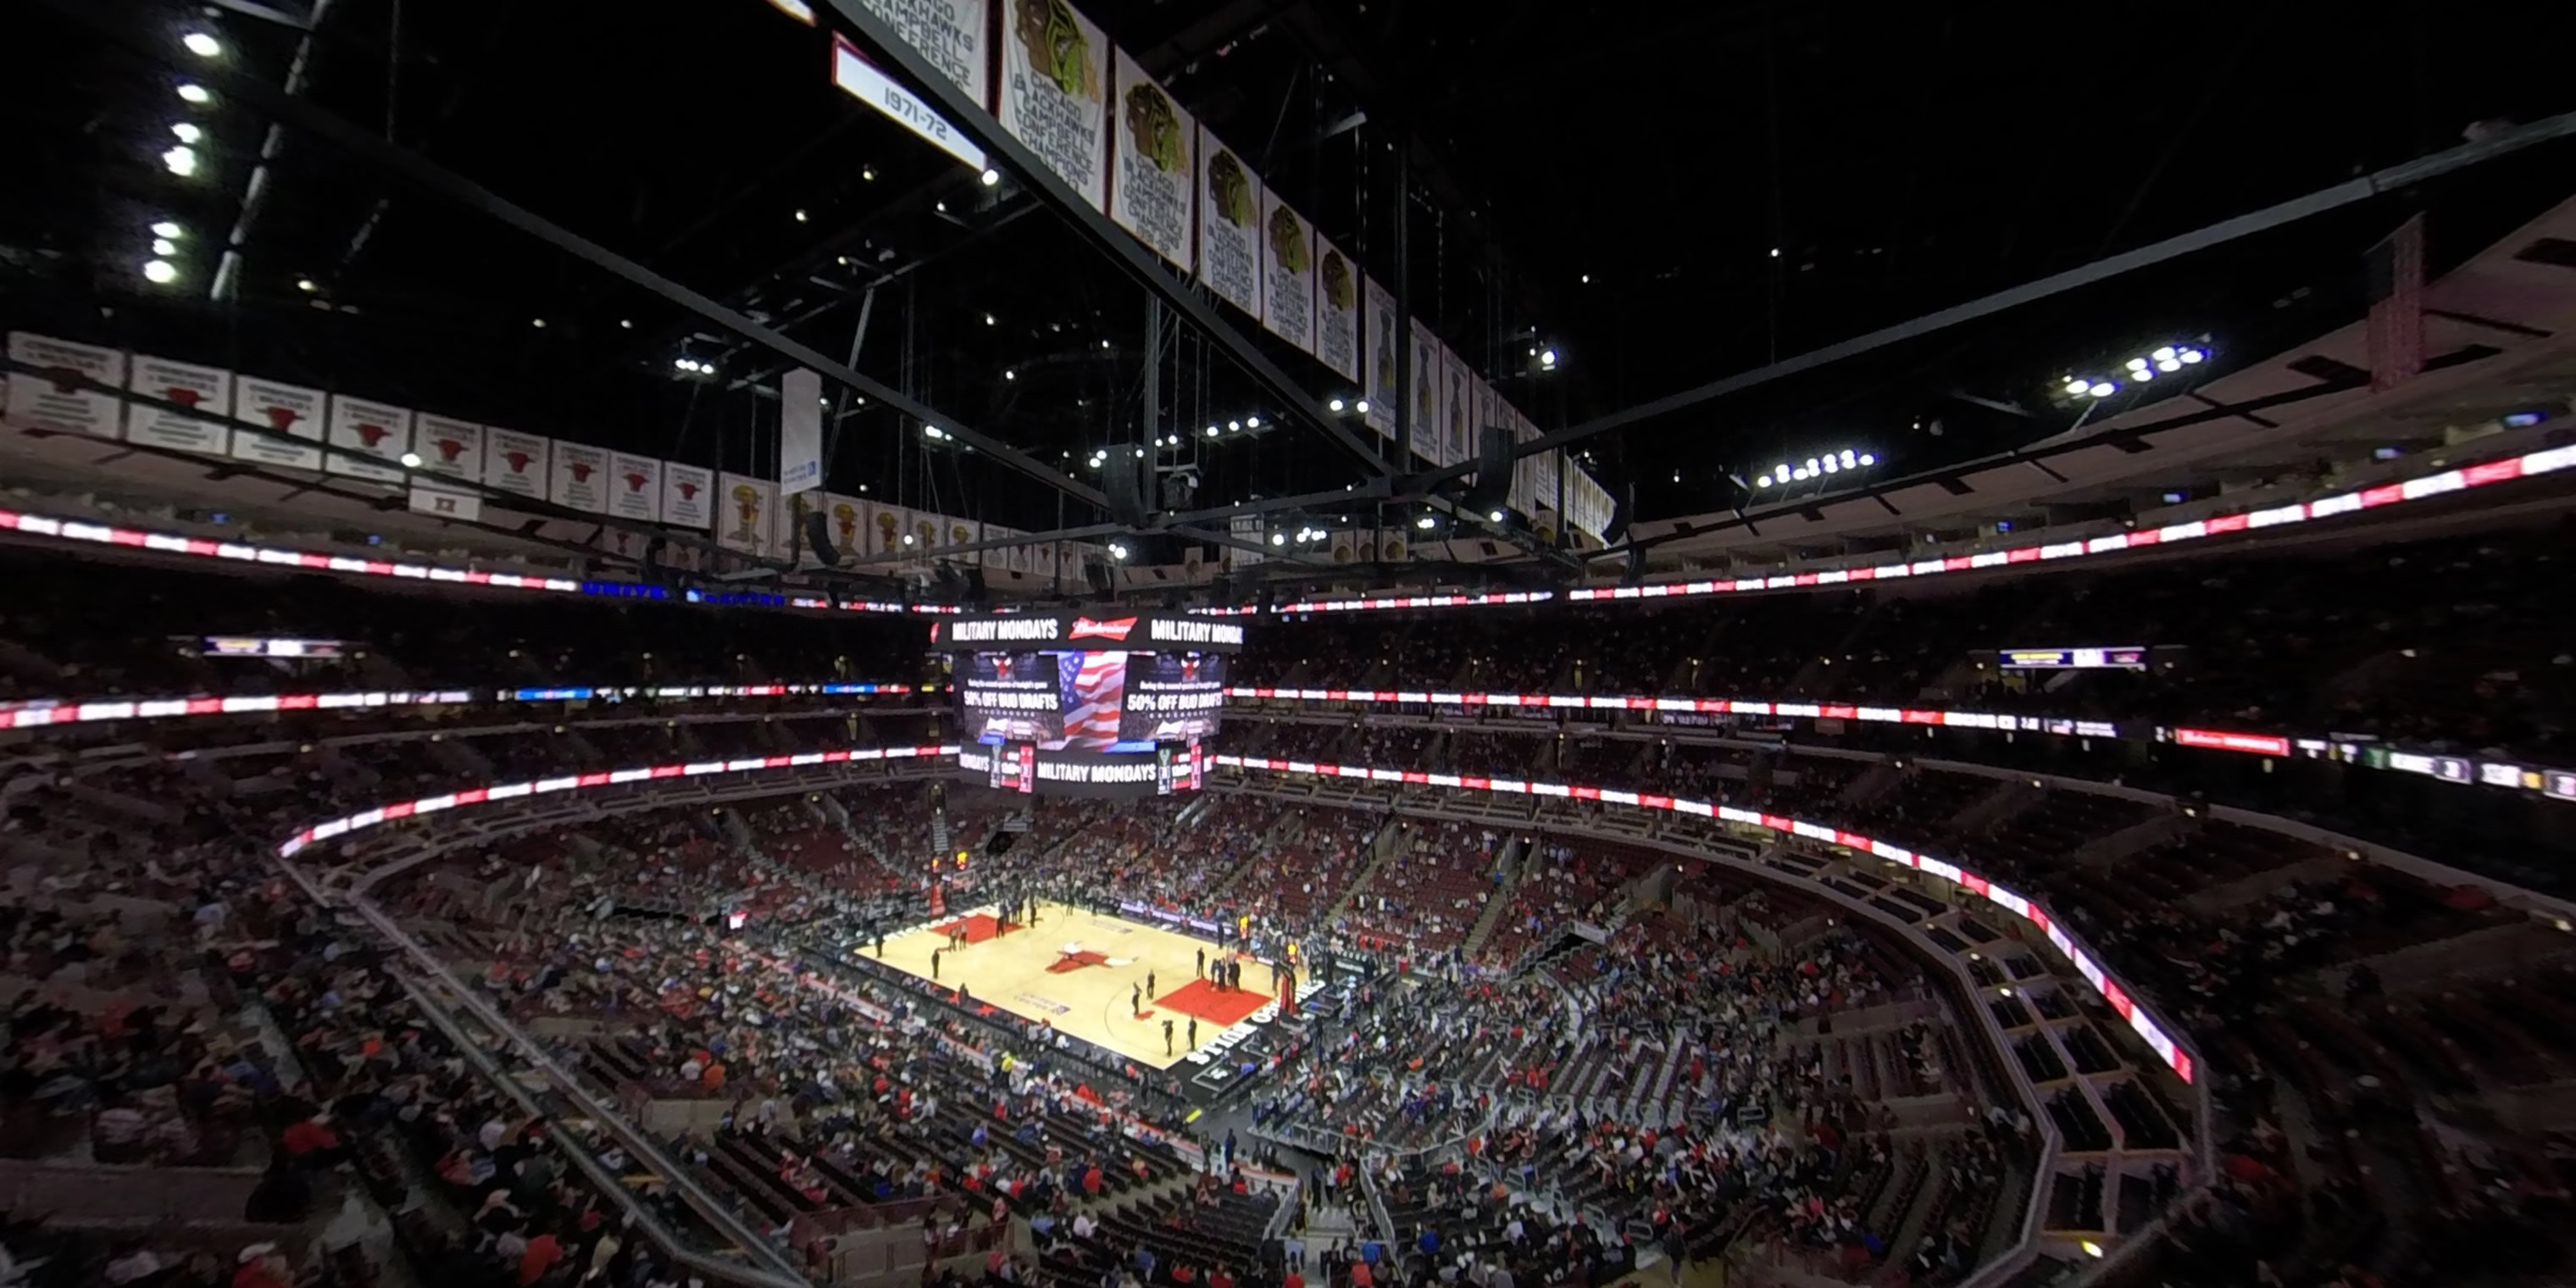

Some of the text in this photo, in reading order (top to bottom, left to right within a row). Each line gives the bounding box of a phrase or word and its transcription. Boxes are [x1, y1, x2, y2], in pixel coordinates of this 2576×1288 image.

[885, 87, 947, 141] 1971-72
[1013, 73, 1095, 147] BLACKHAWKS
[1030, 69, 1082, 122] CHICAGO
[1014, 107, 1096, 176] CONFERENCE
[1023, 94, 1090, 159] CAMPBELL
[1019, 128, 1089, 186] CHAMPIONS
[952, 619, 1058, 641] MILITARY MONDAYS
[1151, 619, 1210, 641] MILITARY
[963, 691, 1058, 710] 50% OFF BUD DRAFTS
[1127, 694, 1156, 711] 50%
[1158, 694, 1178, 710] OFF
[1179, 692, 1198, 709] BUD
[1037, 762, 1090, 782] MILITARY
[1091, 763, 1157, 783] MONDAYS
